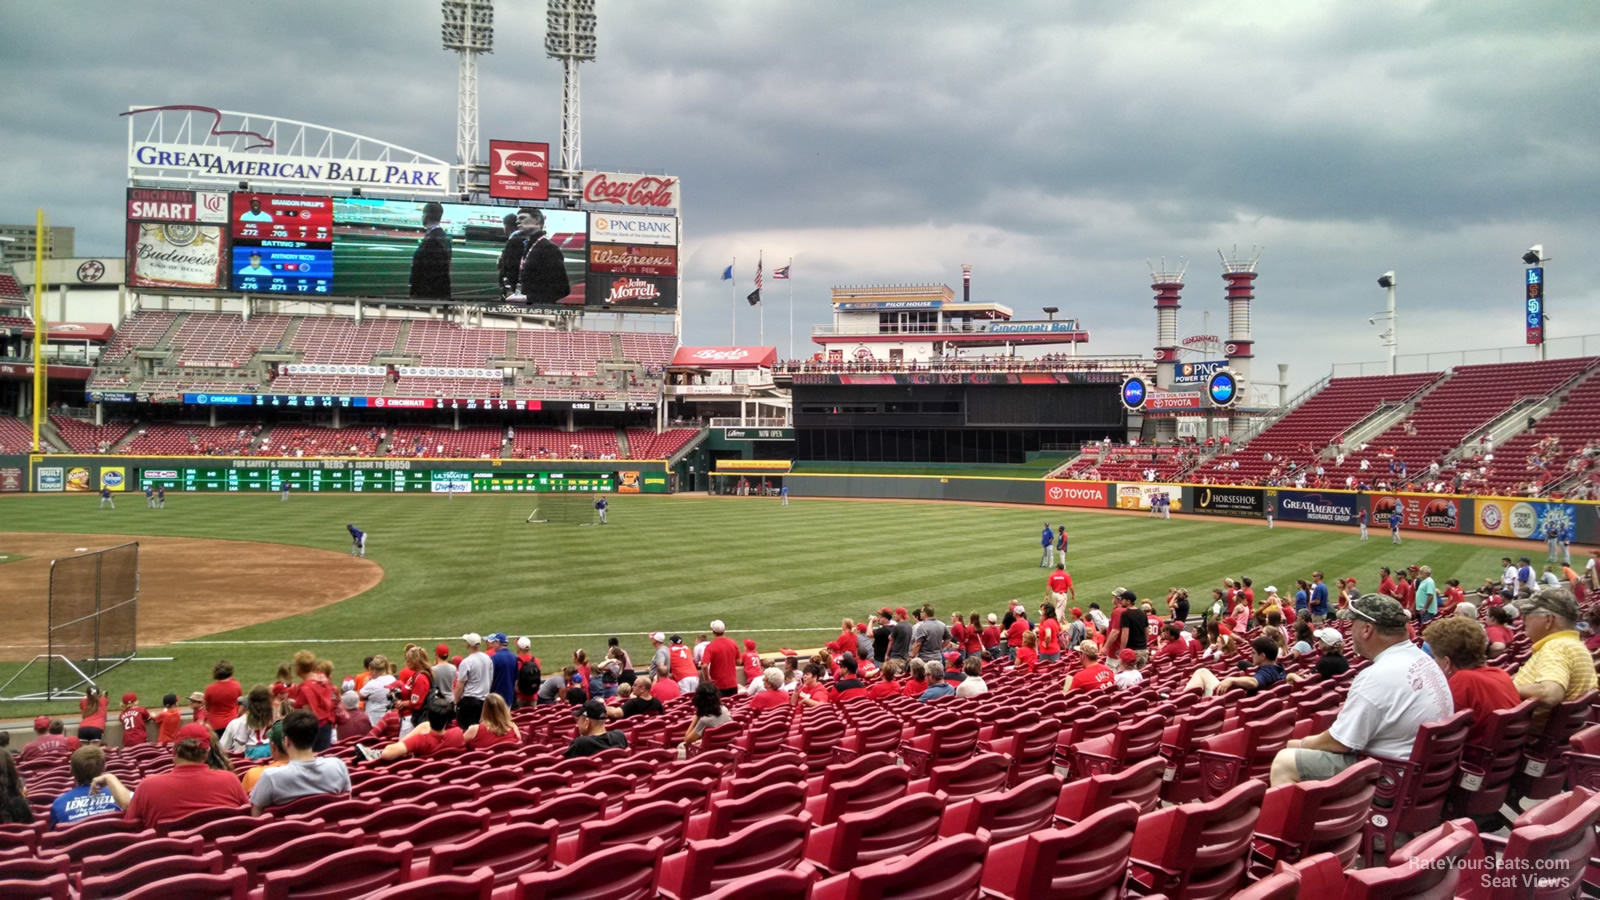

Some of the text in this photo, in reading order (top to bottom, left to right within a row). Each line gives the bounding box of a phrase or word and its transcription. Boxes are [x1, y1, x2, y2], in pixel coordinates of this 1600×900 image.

[136, 146, 440, 186] GREAT AMERICAN BALL PARK
[506, 160, 543, 168] FORMICA
[584, 174, 676, 207] Coca-Cola
[272, 199, 300, 207] BRANDON
[132, 202, 193, 220] SMART
[610, 220, 671, 233] PNC BANK
[262, 240, 294, 248] BATTING
[136, 243, 219, 266] Budweiser
[593, 250, 672, 267] Walgreens
[625, 278, 647, 288] John
[605, 284, 661, 302] Morrell
[990, 322, 1074, 333] Cincinnati Bell
[1182, 335, 1218, 345] CINCINNATI
[1194, 363, 1218, 375] PNC
[943, 374, 958, 384] VS
[758, 430, 783, 438] NOW OPEN
[233, 460, 246, 468] FOR
[247, 460, 270, 468] SAFETY
[384, 462, 411, 470] 69050
[1064, 489, 1103, 500] TOYOTA
[1213, 495, 1257, 505] HORSESHOE
[1283, 499, 1352, 515] GREAT AMERICAN
[1424, 516, 1443, 524] QUEEN
[680, 650, 687, 659] 4
[752, 656, 761, 666] 21
[124, 716, 135, 730] 21
[65, 796, 115, 812] LENZ FIELD
